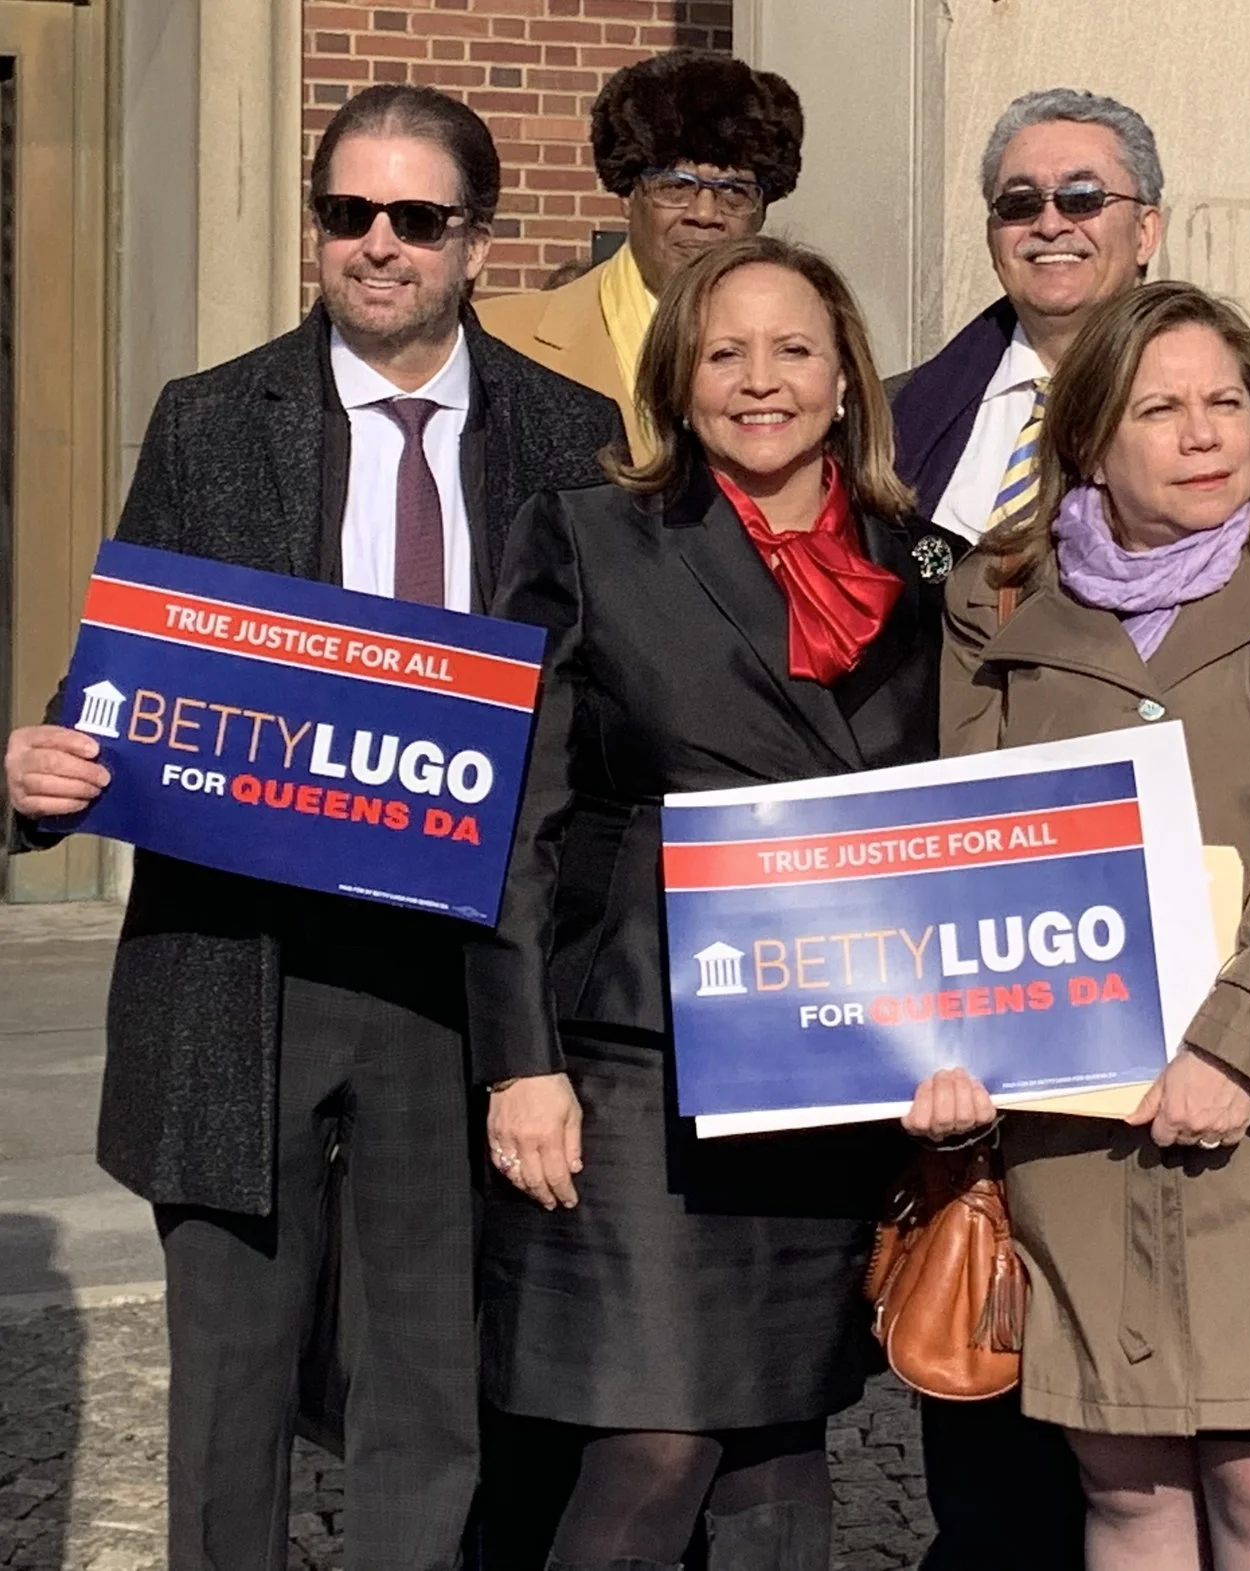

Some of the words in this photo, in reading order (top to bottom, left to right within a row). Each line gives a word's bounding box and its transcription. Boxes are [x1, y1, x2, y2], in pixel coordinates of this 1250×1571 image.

[166, 604, 233, 640] TRUE
[234, 625, 339, 661] JUSTICE
[346, 642, 400, 671] FOR
[404, 652, 454, 682] ALL
[161, 763, 226, 796] FOR
[231, 773, 411, 830] QUEENS
[423, 808, 481, 845] DA
[758, 846, 829, 874] TRUE
[833, 835, 942, 869] JUSTICE
[948, 829, 1003, 856] FOR
[1008, 822, 1057, 849] ALL
[800, 1004, 865, 1029] FOR
[870, 980, 1054, 1027] QUEENS
[1069, 972, 1129, 1007] DA
